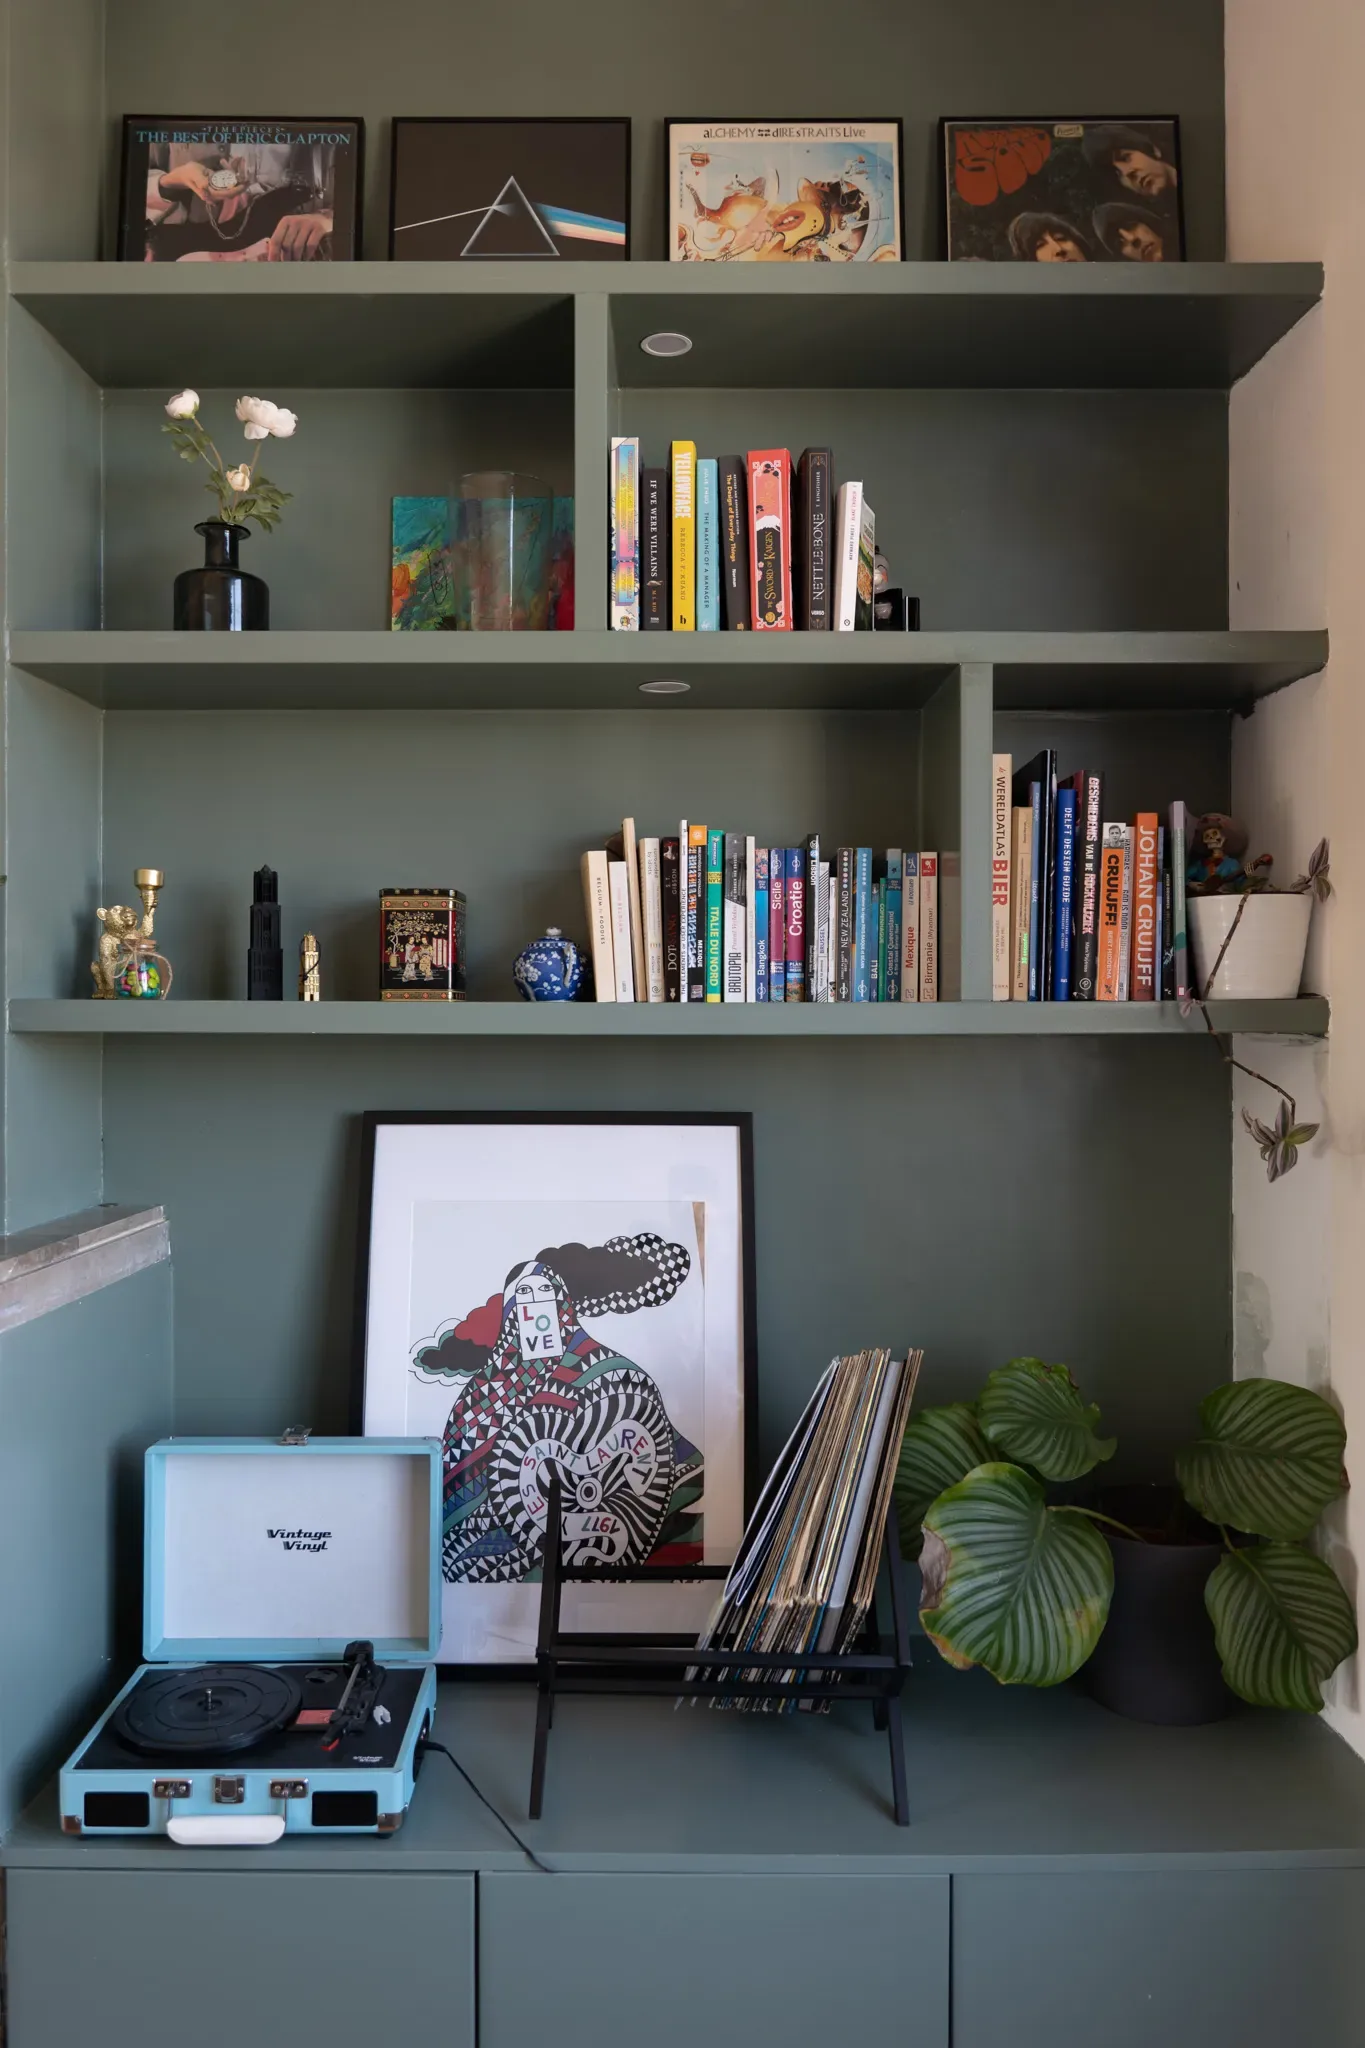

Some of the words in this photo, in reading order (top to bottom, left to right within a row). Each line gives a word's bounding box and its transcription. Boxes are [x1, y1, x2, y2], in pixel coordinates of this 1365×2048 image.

[136, 131, 168, 143] THE
[172, 131, 209, 143] BEST
[212, 132, 231, 144] OF
[235, 132, 273, 144] ERIC
[274, 133, 351, 145] CLAPTON
[650, 480, 657, 489] IF
[650, 491, 658, 505] WE
[674, 452, 692, 519] YELLOWFACE
[726, 486, 735, 506] Design
[650, 508, 658, 532] WERE
[728, 515, 737, 542] Everyday
[813, 513, 825, 546] BONE
[650, 534, 658, 577] VILLAINS
[704, 557, 710, 566] OF
[730, 543, 738, 562] Things
[762, 531, 776, 560] KAIGEN
[763, 568, 777, 600] SWORD
[813, 550, 825, 600] NETTLE
[995, 776, 1006, 857] WERELDATLAS
[1063, 807, 1073, 835] DELFT
[1086, 777, 1100, 842] GESCHIEDENIS
[1063, 838, 1072, 872] DESIGN
[1085, 844, 1094, 859] VAN
[1085, 863, 1093, 872] DE
[1138, 825, 1155, 899] JOHAN
[810, 859, 818, 886] Lisbon
[992, 859, 1009, 906] BIER
[771, 881, 782, 910] Sicile
[1062, 875, 1070, 903] GUIDE
[1082, 873, 1096, 935] ROCKMUZIEK
[1105, 854, 1120, 927] CRUIJFF!
[709, 906, 720, 939] ITALIE
[789, 881, 803, 937] Croatie
[841, 890, 849, 928] ZEALAND
[927, 908, 935, 940] (Myanmar)
[841, 928, 849, 948] NEW
[887, 911, 895, 950] Queensland
[1136, 903, 1153, 986] CRUIJFF
[667, 945, 678, 971] DOT
[709, 939, 720, 955] DU
[756, 939, 767, 976] Bangkok
[905, 926, 916, 969] Mexique
[924, 942, 933, 984] Birmanie
[709, 955, 720, 986] NORD
[728, 952, 742, 993] BRUTOPIA
[887, 951, 895, 976] Coastal
[523, 1306, 554, 1352] LOVE
[523, 1443, 581, 1470] SAINT
[587, 1429, 653, 1485] LAURENT
[266, 1529, 333, 1541] Vintage
[282, 1541, 329, 1553] Vinyl
